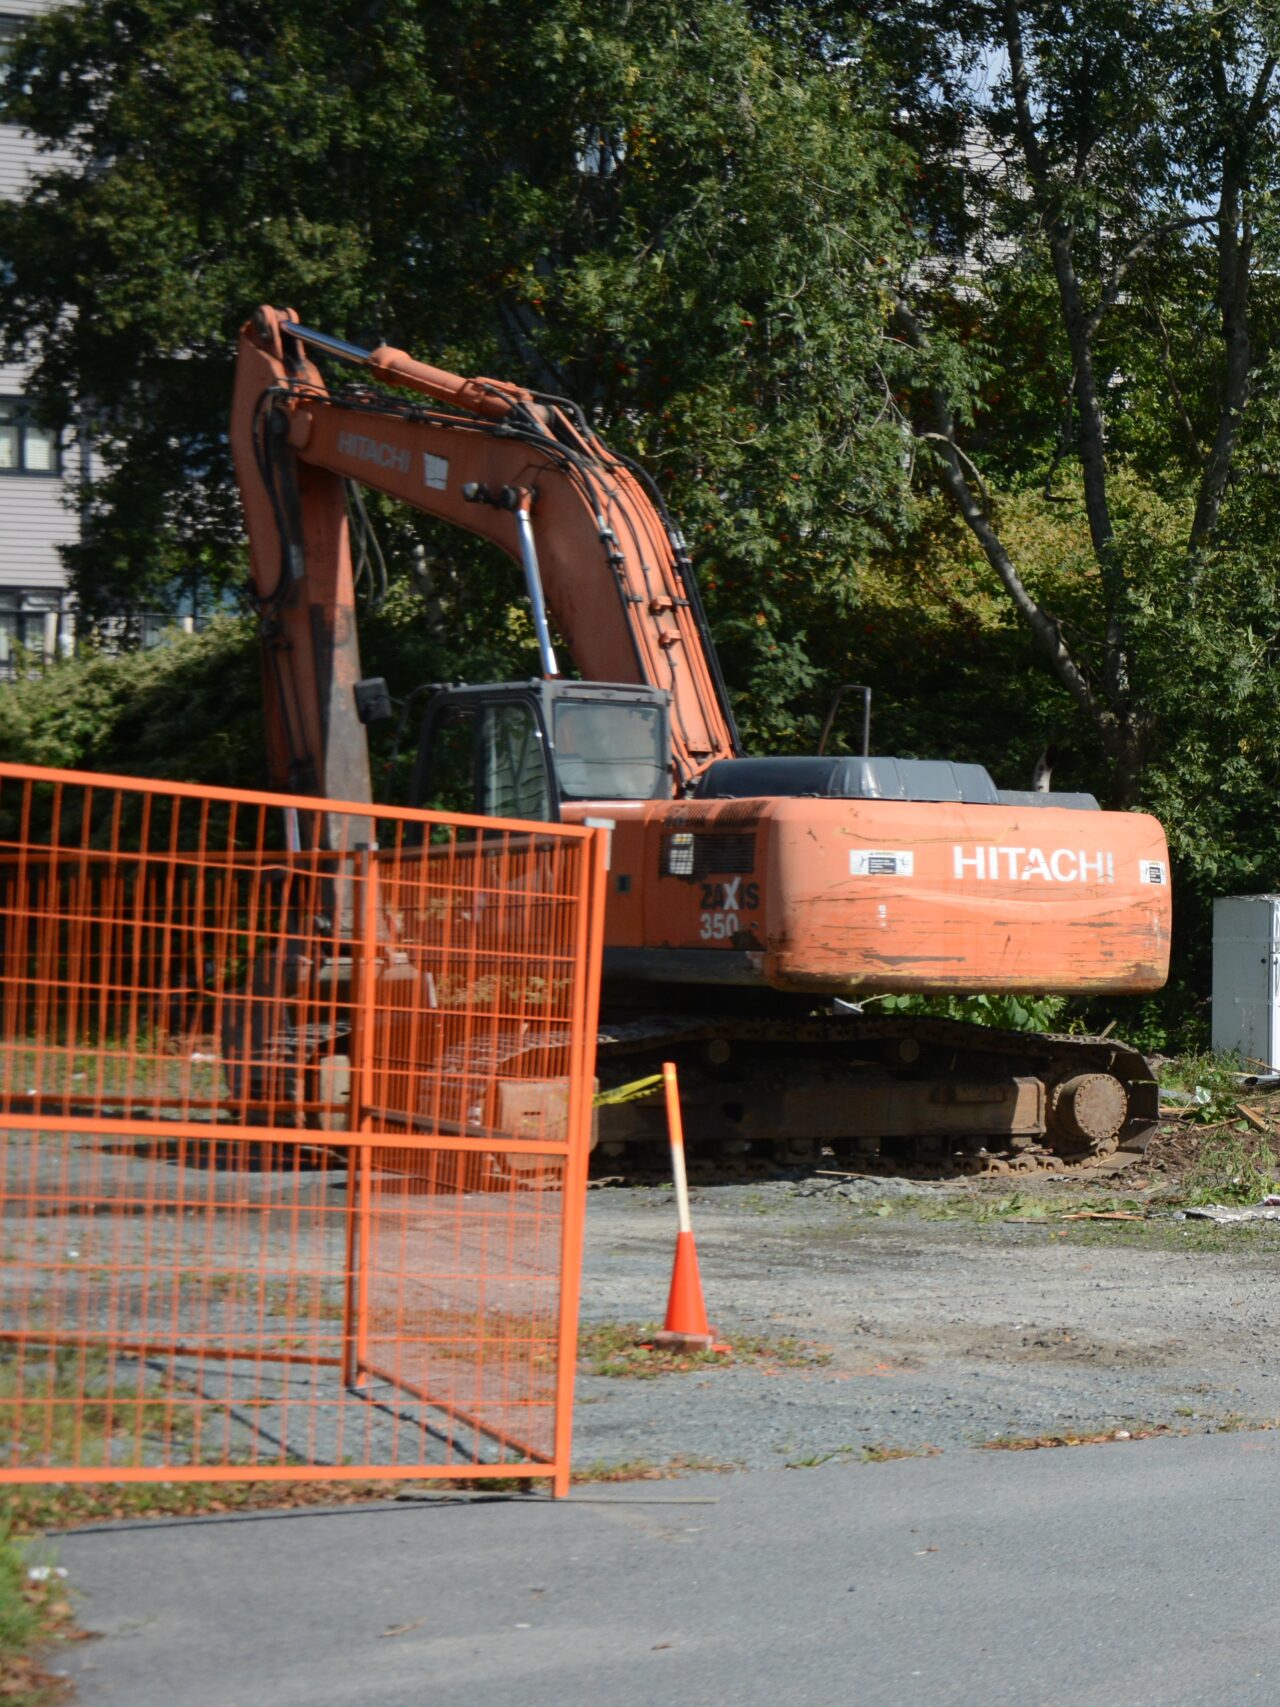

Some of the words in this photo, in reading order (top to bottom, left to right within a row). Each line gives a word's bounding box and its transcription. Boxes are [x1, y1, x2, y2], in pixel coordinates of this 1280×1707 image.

[337, 431, 411, 474] HITACHI
[953, 846, 1115, 884] HITACHI
[700, 876, 760, 911] ZAXIS
[700, 912, 739, 940] 350
